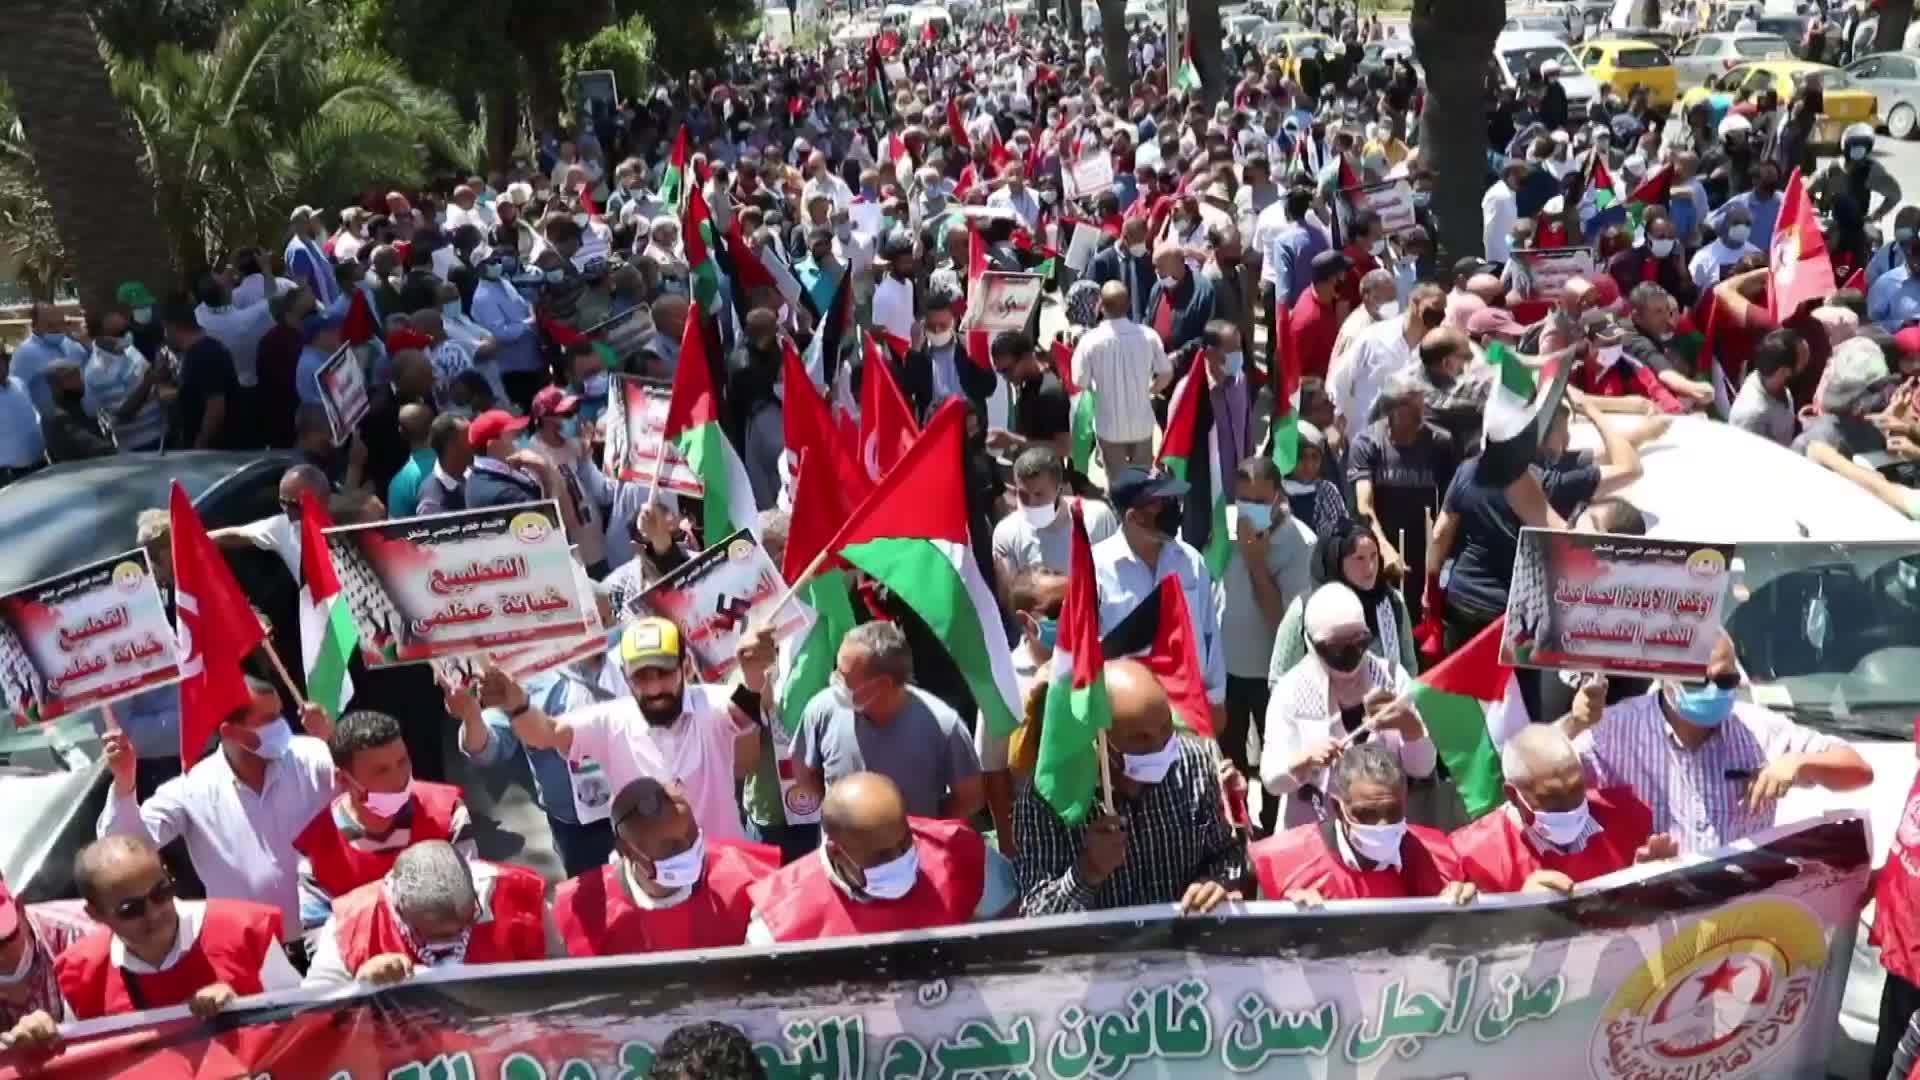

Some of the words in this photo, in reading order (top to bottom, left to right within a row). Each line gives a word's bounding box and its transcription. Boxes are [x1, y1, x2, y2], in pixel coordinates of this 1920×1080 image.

[428, 553, 528, 594] التطبيع
[499, 584, 570, 621] خيانة
[1047, 976, 1210, 1080] قانون
[1222, 991, 1338, 1072] سن
[1345, 955, 1479, 1063] أجل
[1474, 971, 1565, 1042] من
